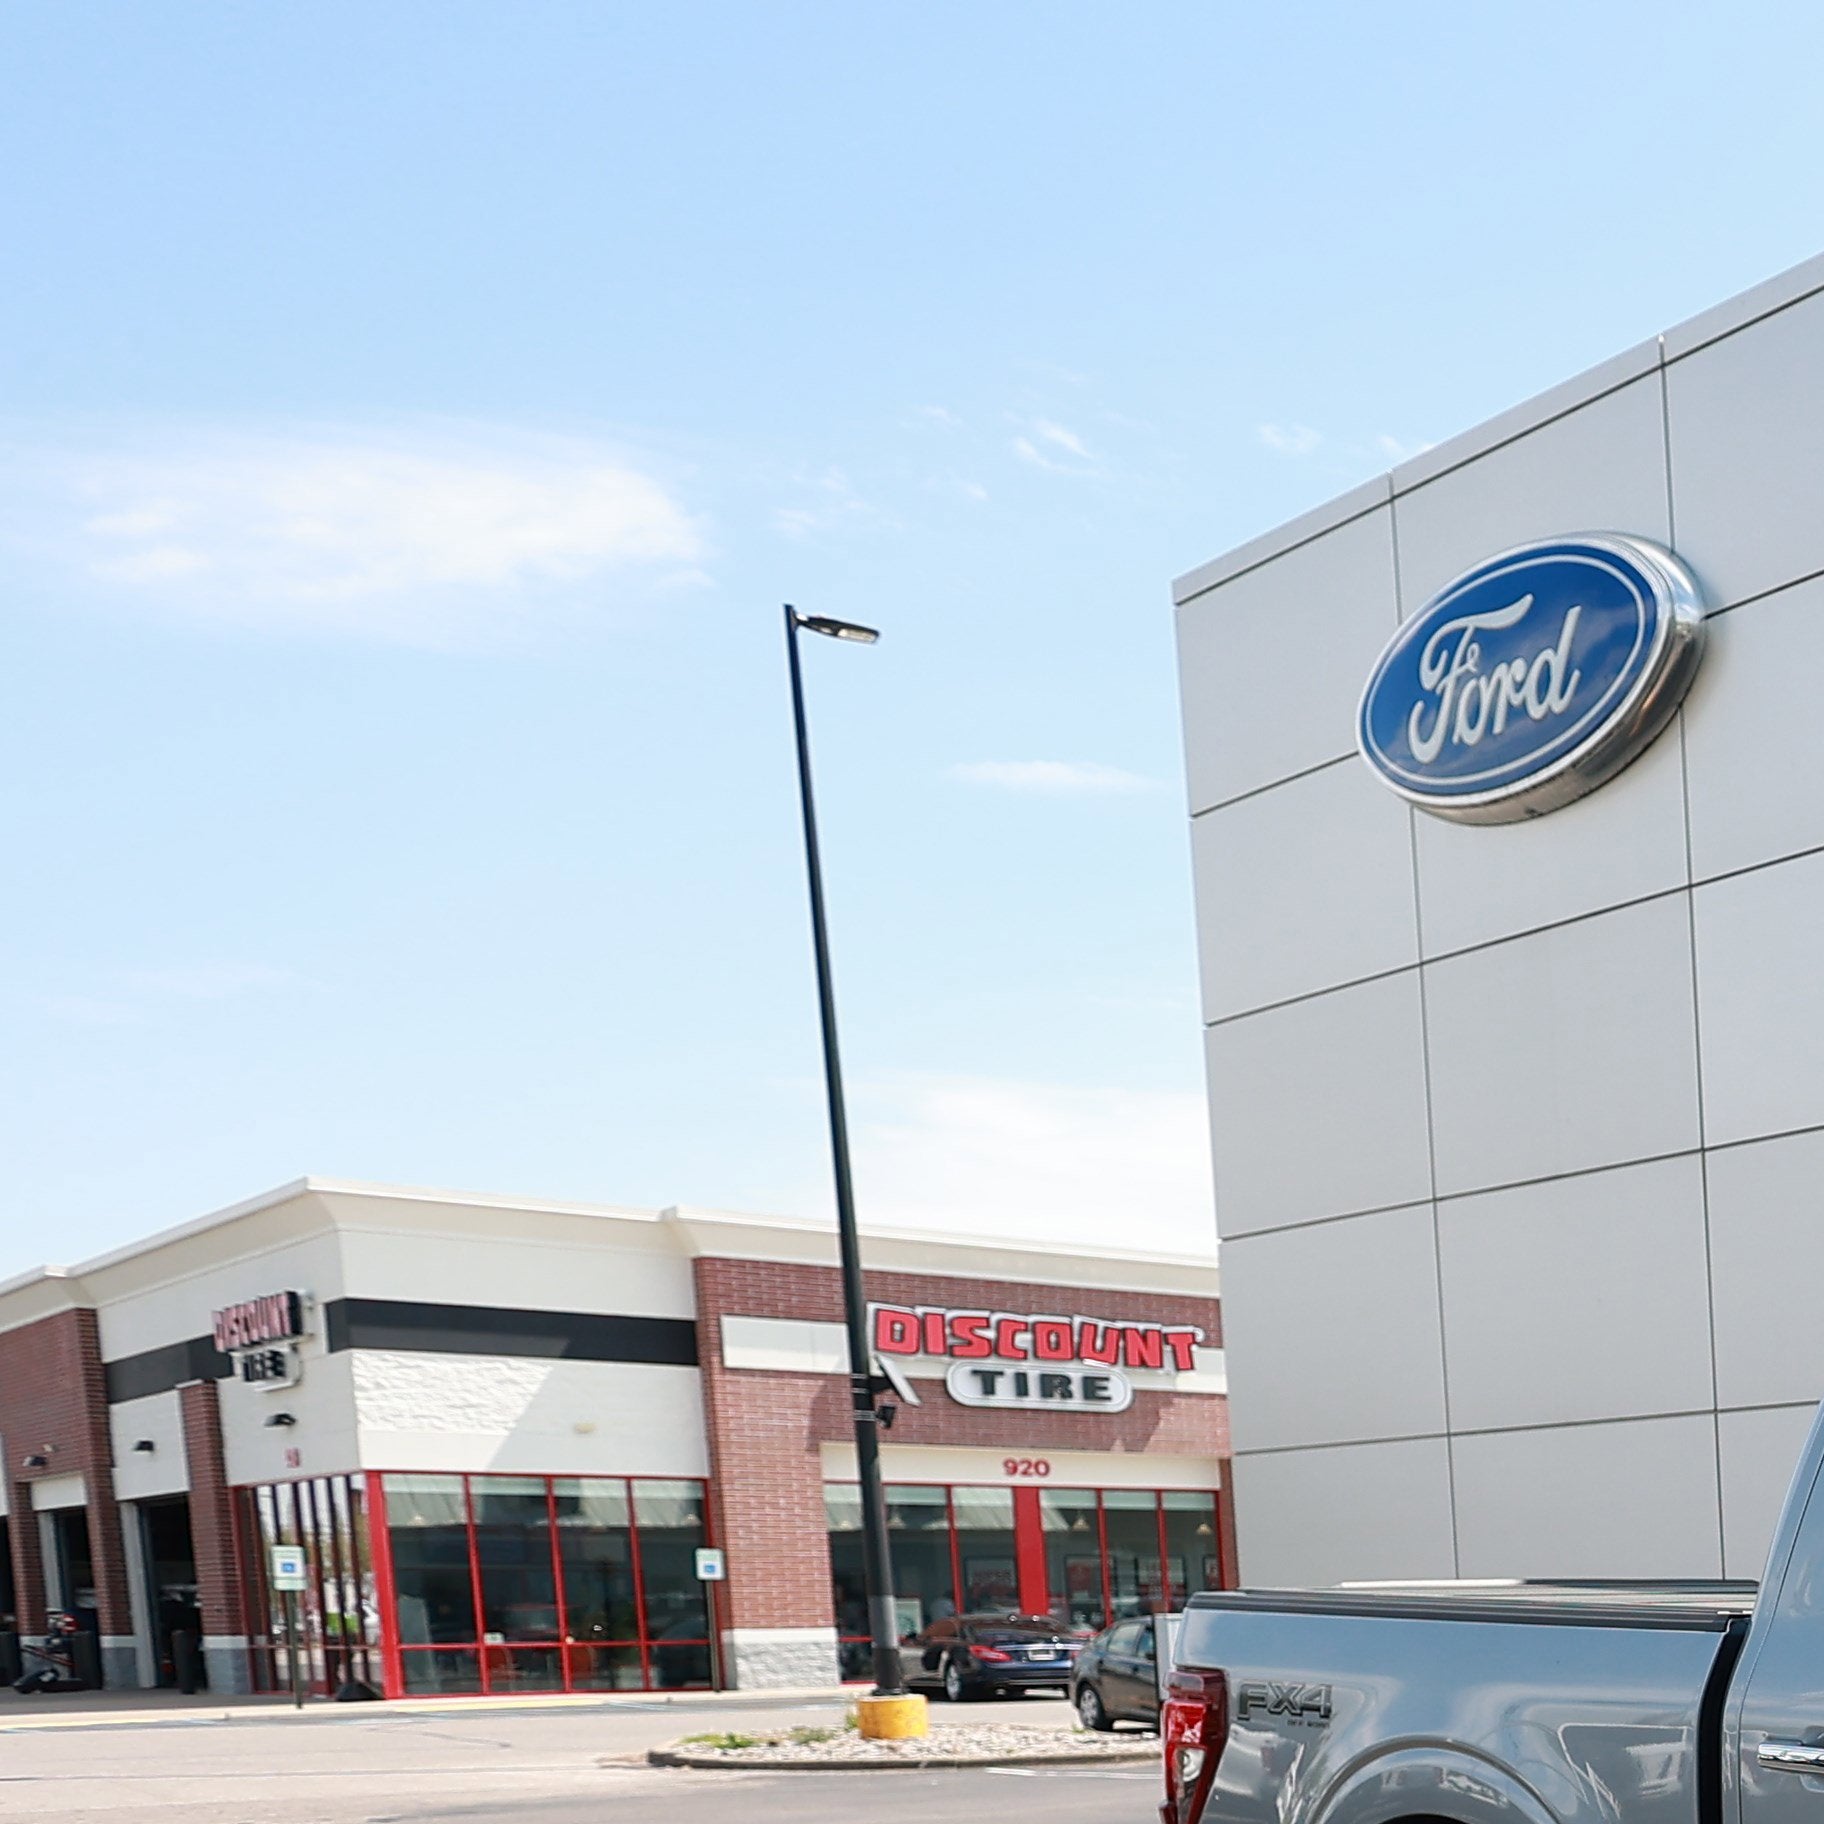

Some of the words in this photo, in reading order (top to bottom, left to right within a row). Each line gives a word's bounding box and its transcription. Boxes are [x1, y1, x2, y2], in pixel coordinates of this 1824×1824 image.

[1408, 593, 1581, 764] Ford
[875, 1306, 1199, 1371] DISCOUNT
[970, 1368, 1113, 1402] TIRE
[1002, 1457, 1051, 1478] 920
[1237, 1682, 1334, 1721] FX4
